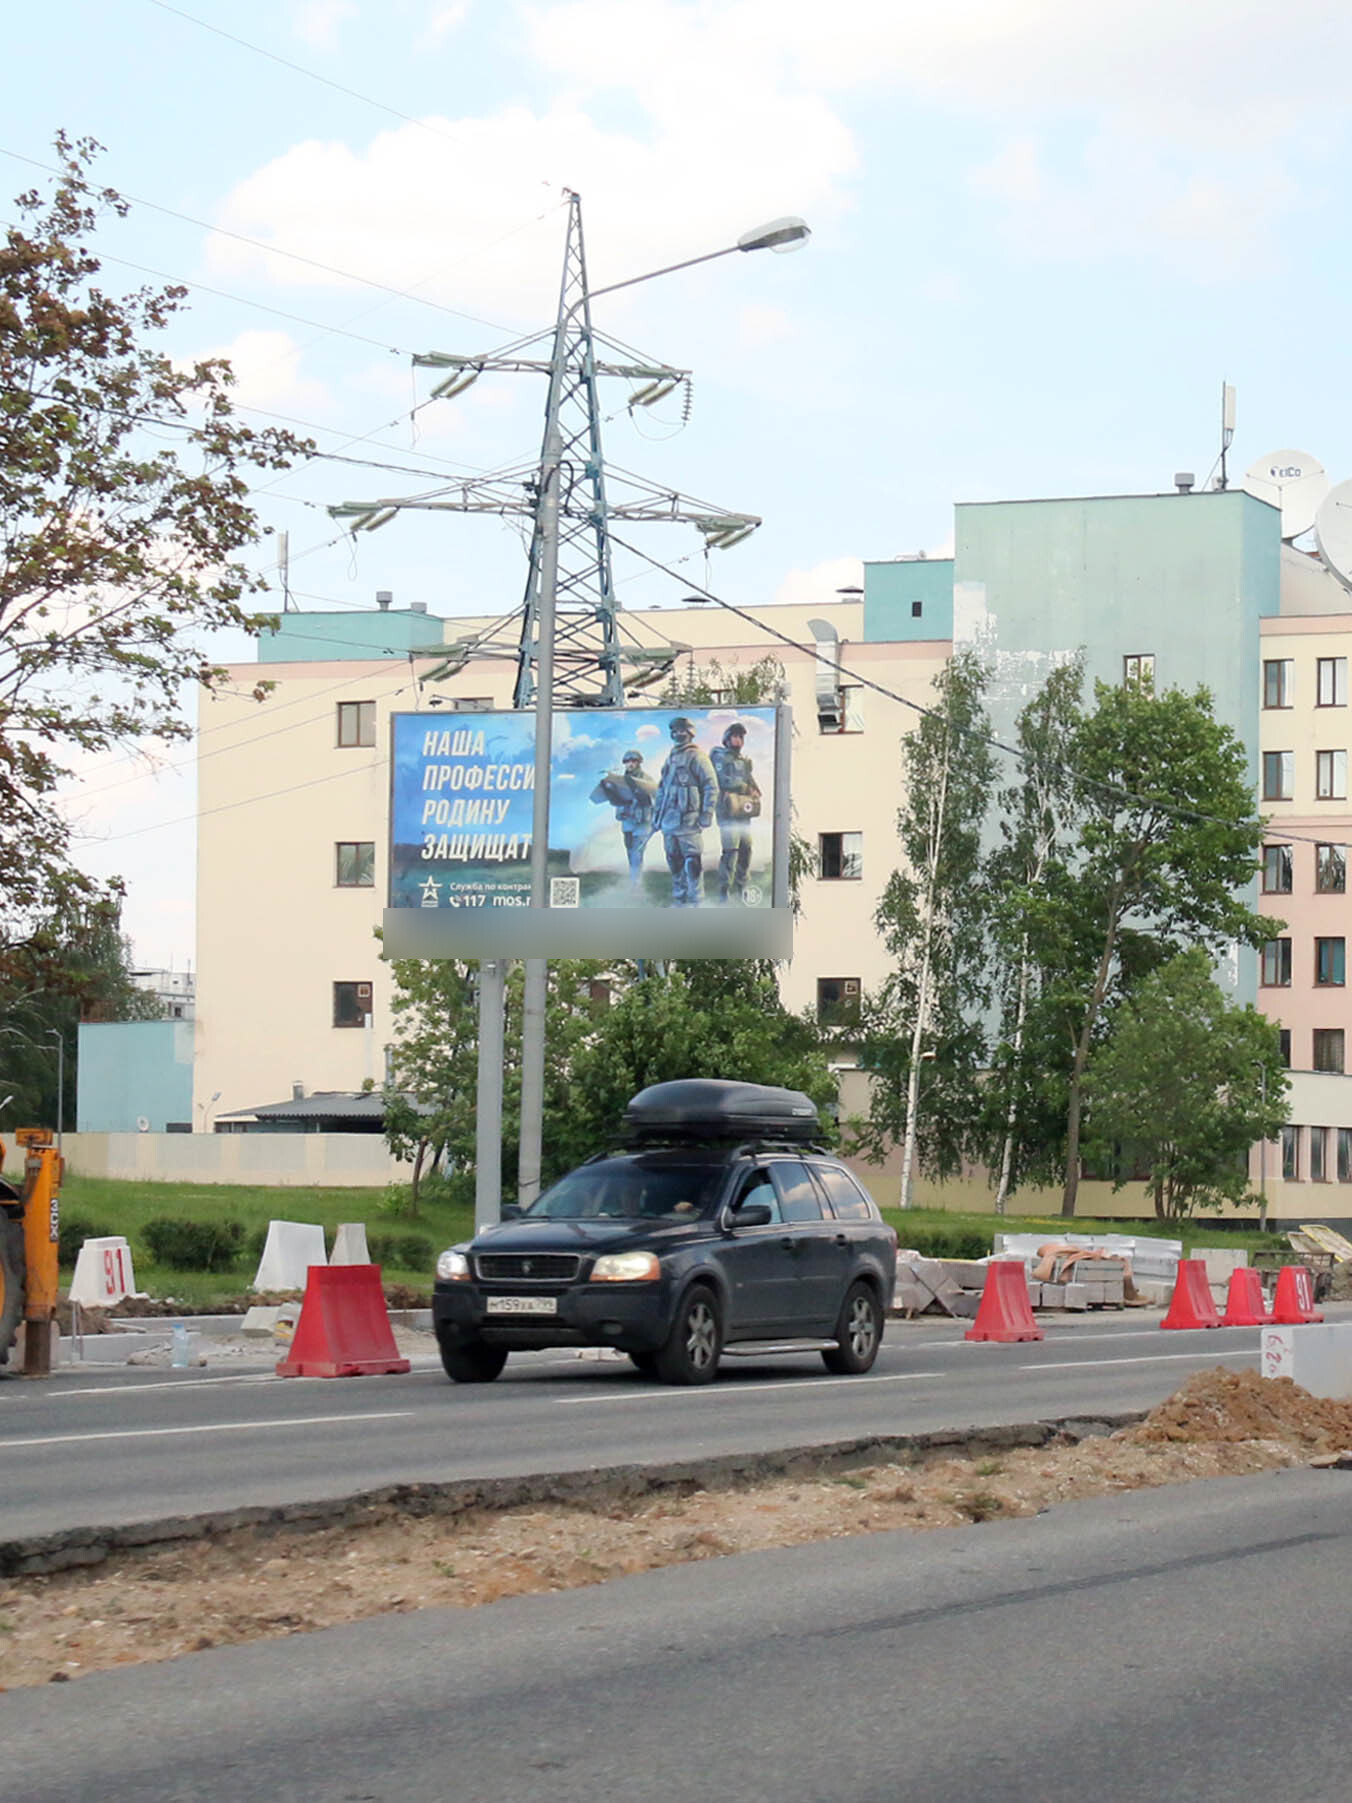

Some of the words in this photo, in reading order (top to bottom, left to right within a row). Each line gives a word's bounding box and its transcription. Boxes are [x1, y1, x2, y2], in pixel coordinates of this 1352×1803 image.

[422, 730, 485, 757] НАША
[422, 763, 536, 791] ПРОФЕССИ
[421, 799, 511, 828] РОДИНУ
[420, 833, 533, 862] ЗАЩИЩАТ
[450, 881, 482, 892] Служба
[464, 895, 486, 907] 117
[492, 895, 531, 907] mos.r
[103, 1248, 126, 1295] 91
